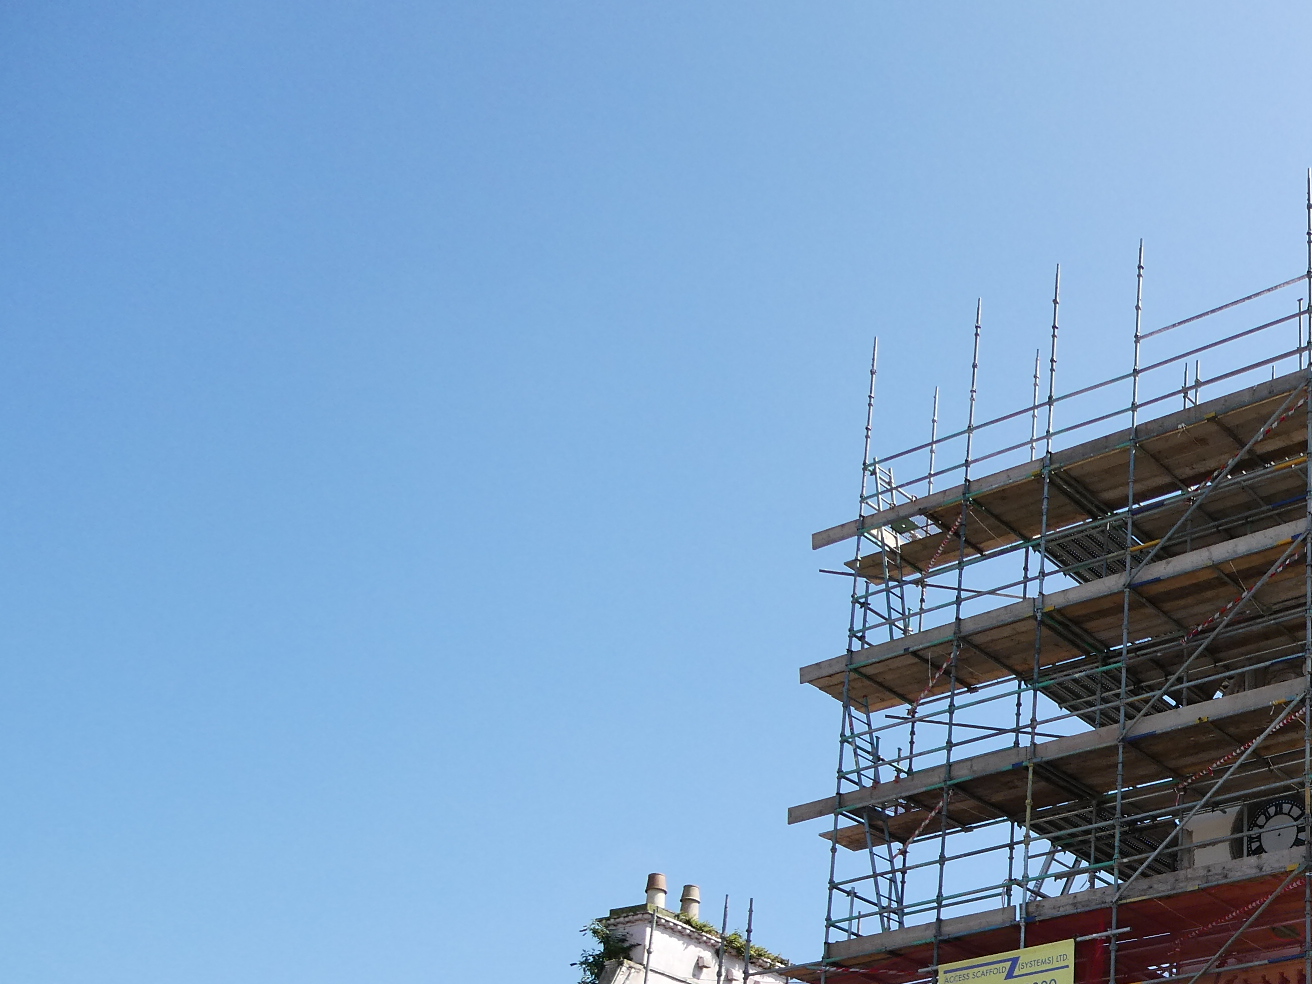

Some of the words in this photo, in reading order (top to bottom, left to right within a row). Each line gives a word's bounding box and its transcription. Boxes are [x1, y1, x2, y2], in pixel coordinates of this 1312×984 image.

[943, 973, 970, 984] ACCESS
[972, 966, 1007, 980] SCAFFOLD
[1018, 957, 1054, 972] (SYSTEMS)
[1056, 953, 1070, 963] LTD.
